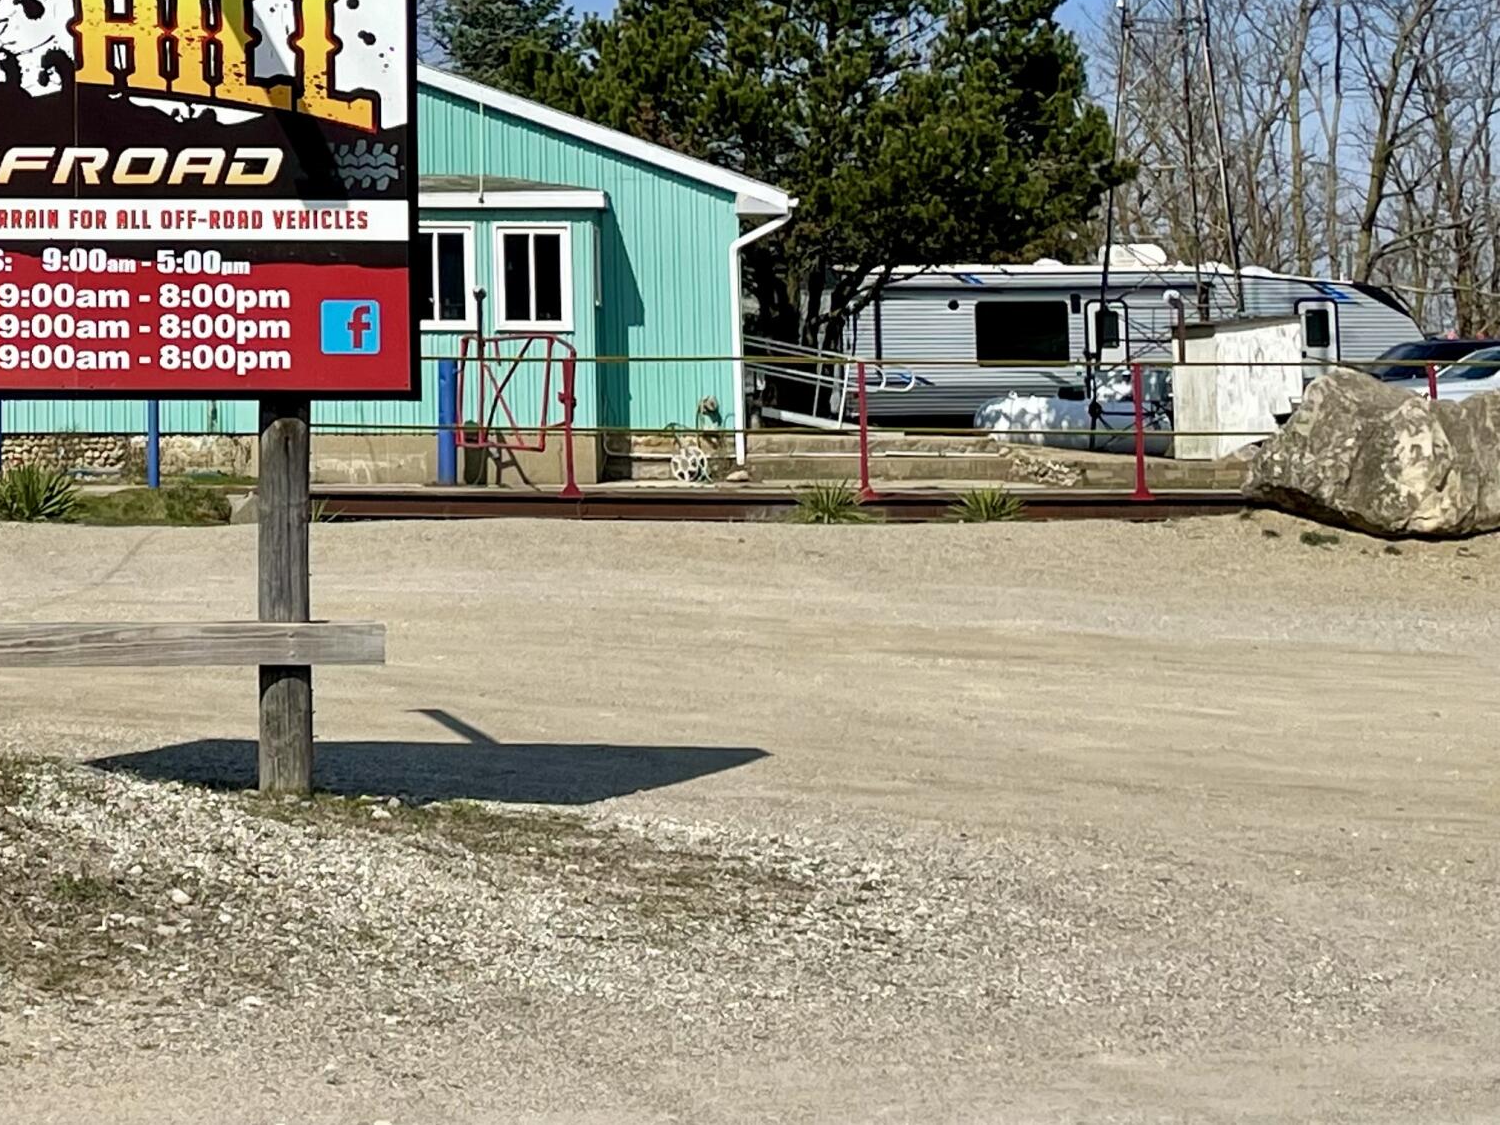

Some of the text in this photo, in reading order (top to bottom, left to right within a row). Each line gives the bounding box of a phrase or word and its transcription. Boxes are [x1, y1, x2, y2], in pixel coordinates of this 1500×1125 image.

[69, 209, 107, 229] FOR
[116, 210, 152, 229] ALL
[160, 210, 263, 230] OFF-ROAD
[272, 210, 369, 230] VEHICLES
[41, 248, 137, 273] 9:00am
[156, 250, 251, 275] 5:00pm
[158, 283, 291, 314] 8:00pm
[158, 313, 291, 344] 8:00pm
[158, 344, 291, 375] 8:00pm
